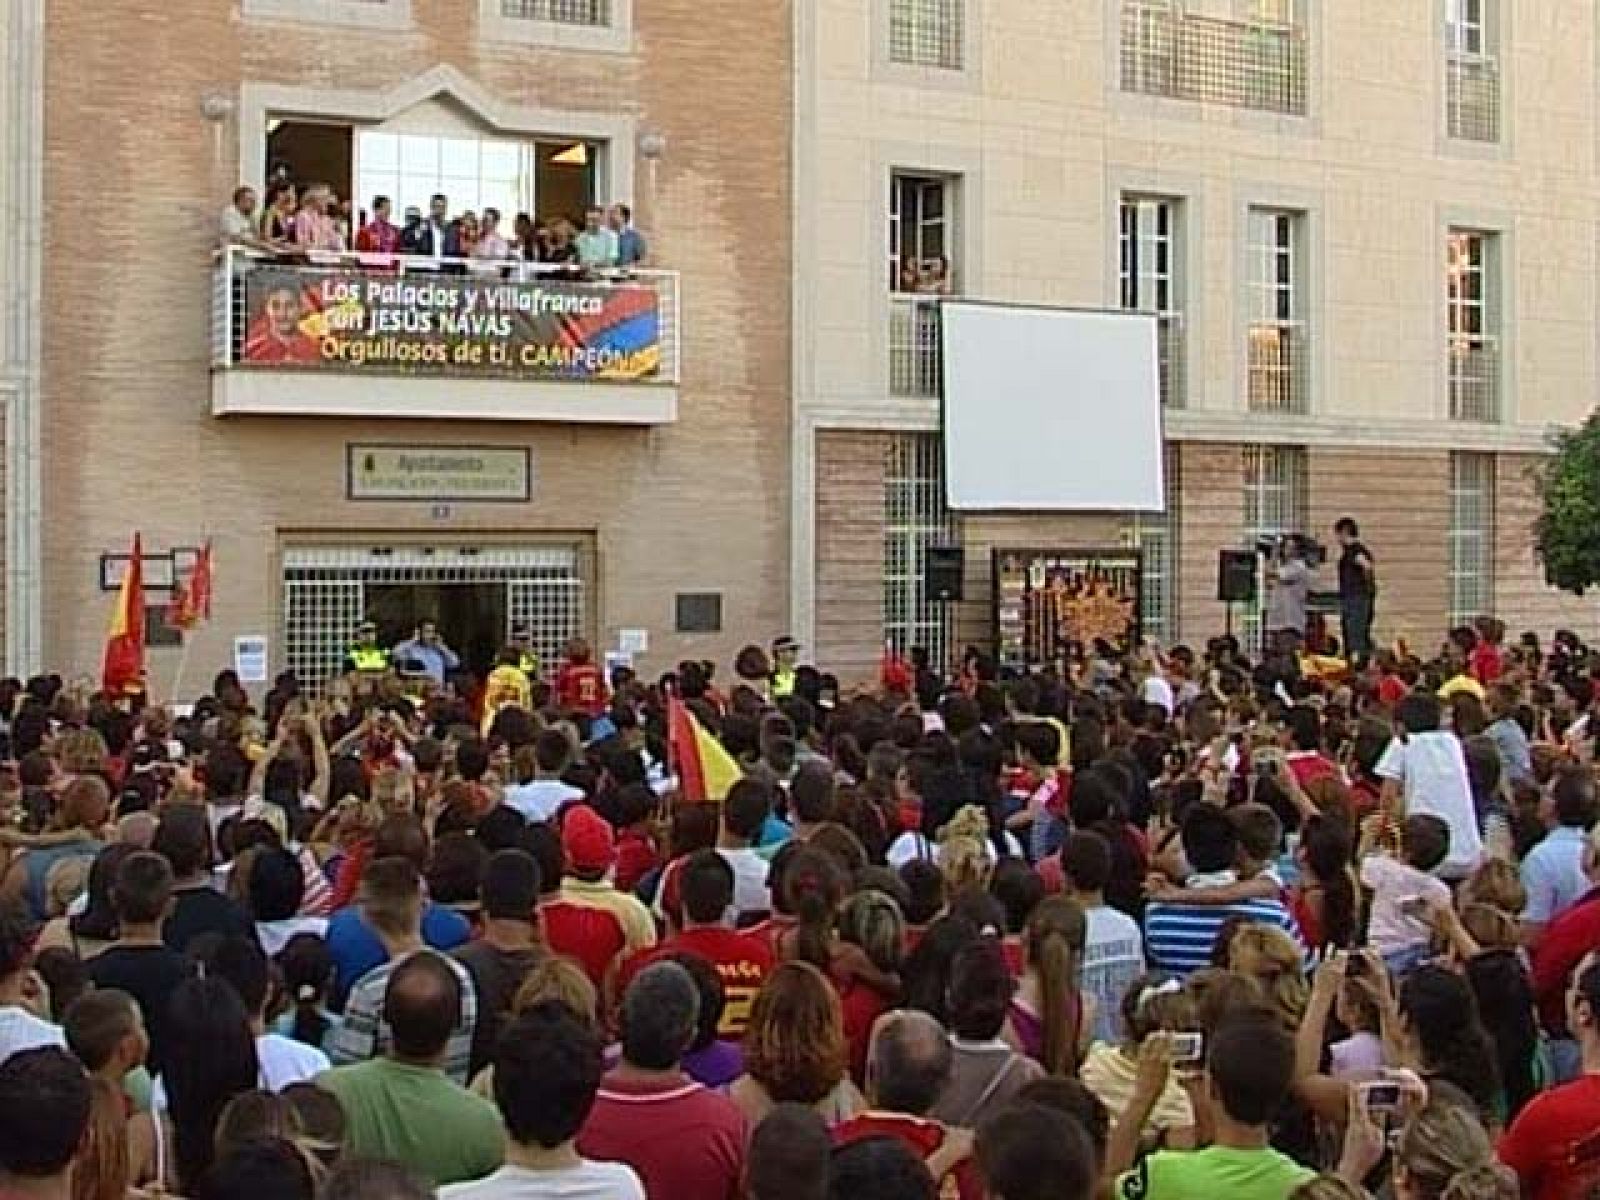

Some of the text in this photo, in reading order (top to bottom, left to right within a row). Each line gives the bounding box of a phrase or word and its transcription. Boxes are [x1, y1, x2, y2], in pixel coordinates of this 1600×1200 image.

[321, 279, 604, 316] Los Palacios y Villafranca
[439, 313, 512, 337] NAVAS
[321, 336, 447, 366] Orgullosos
[454, 338, 481, 364] de
